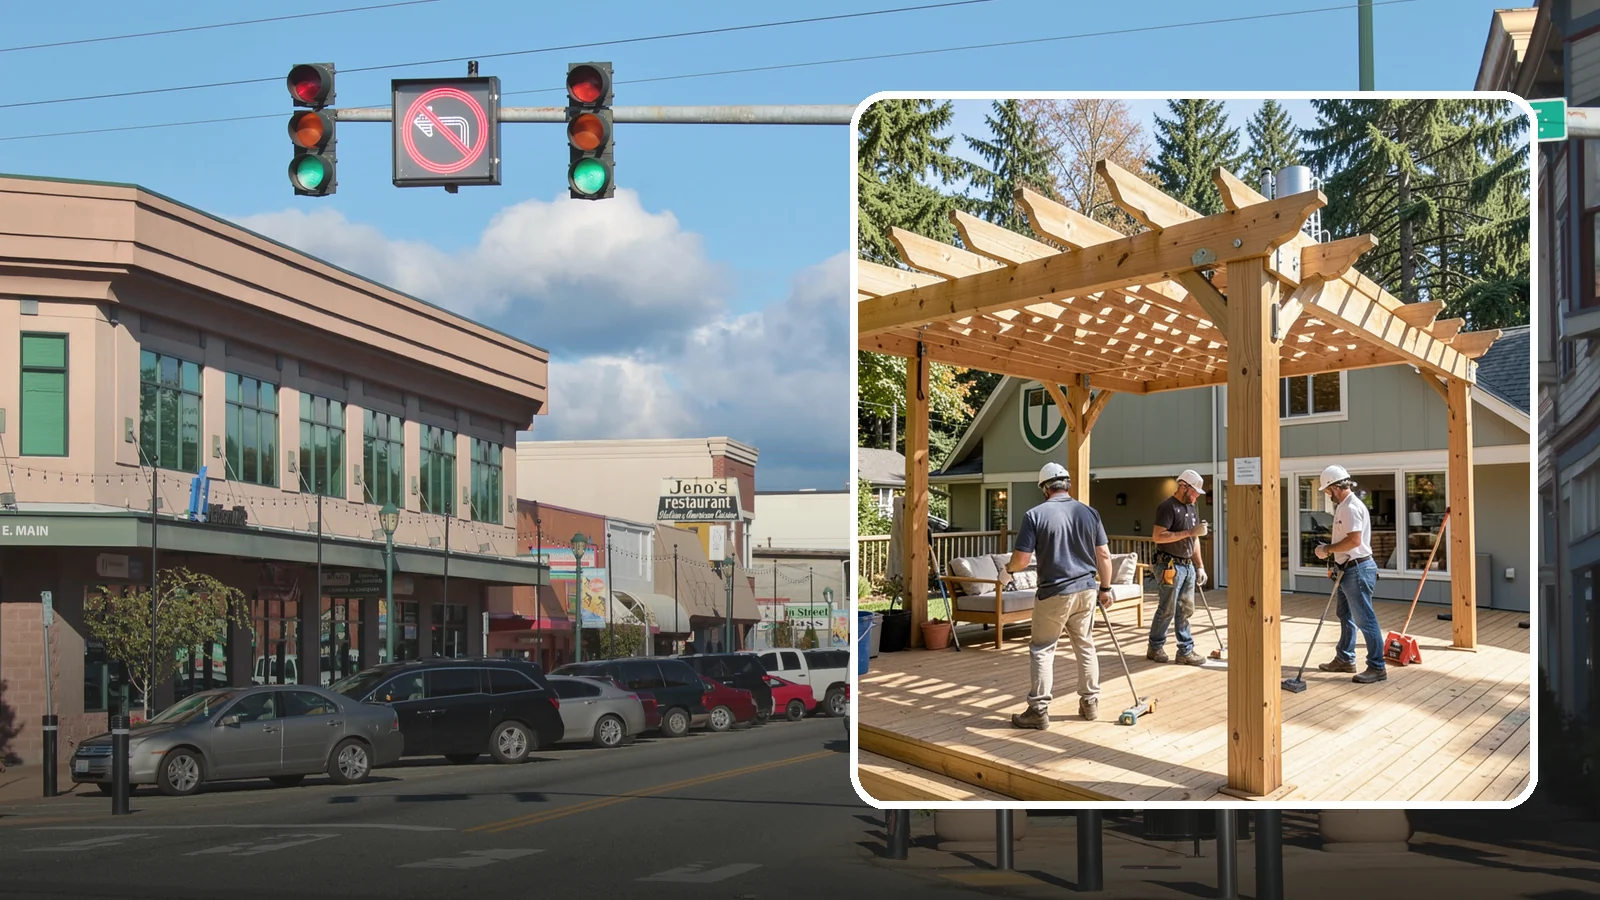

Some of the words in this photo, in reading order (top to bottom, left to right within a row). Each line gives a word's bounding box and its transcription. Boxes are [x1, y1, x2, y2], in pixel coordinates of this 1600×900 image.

[669, 480, 728, 494] Jeno's
[665, 496, 731, 509] restaurant
[2, 525, 13, 536] E.
[15, 525, 49, 536] MAIN
[797, 607, 828, 617] Street
